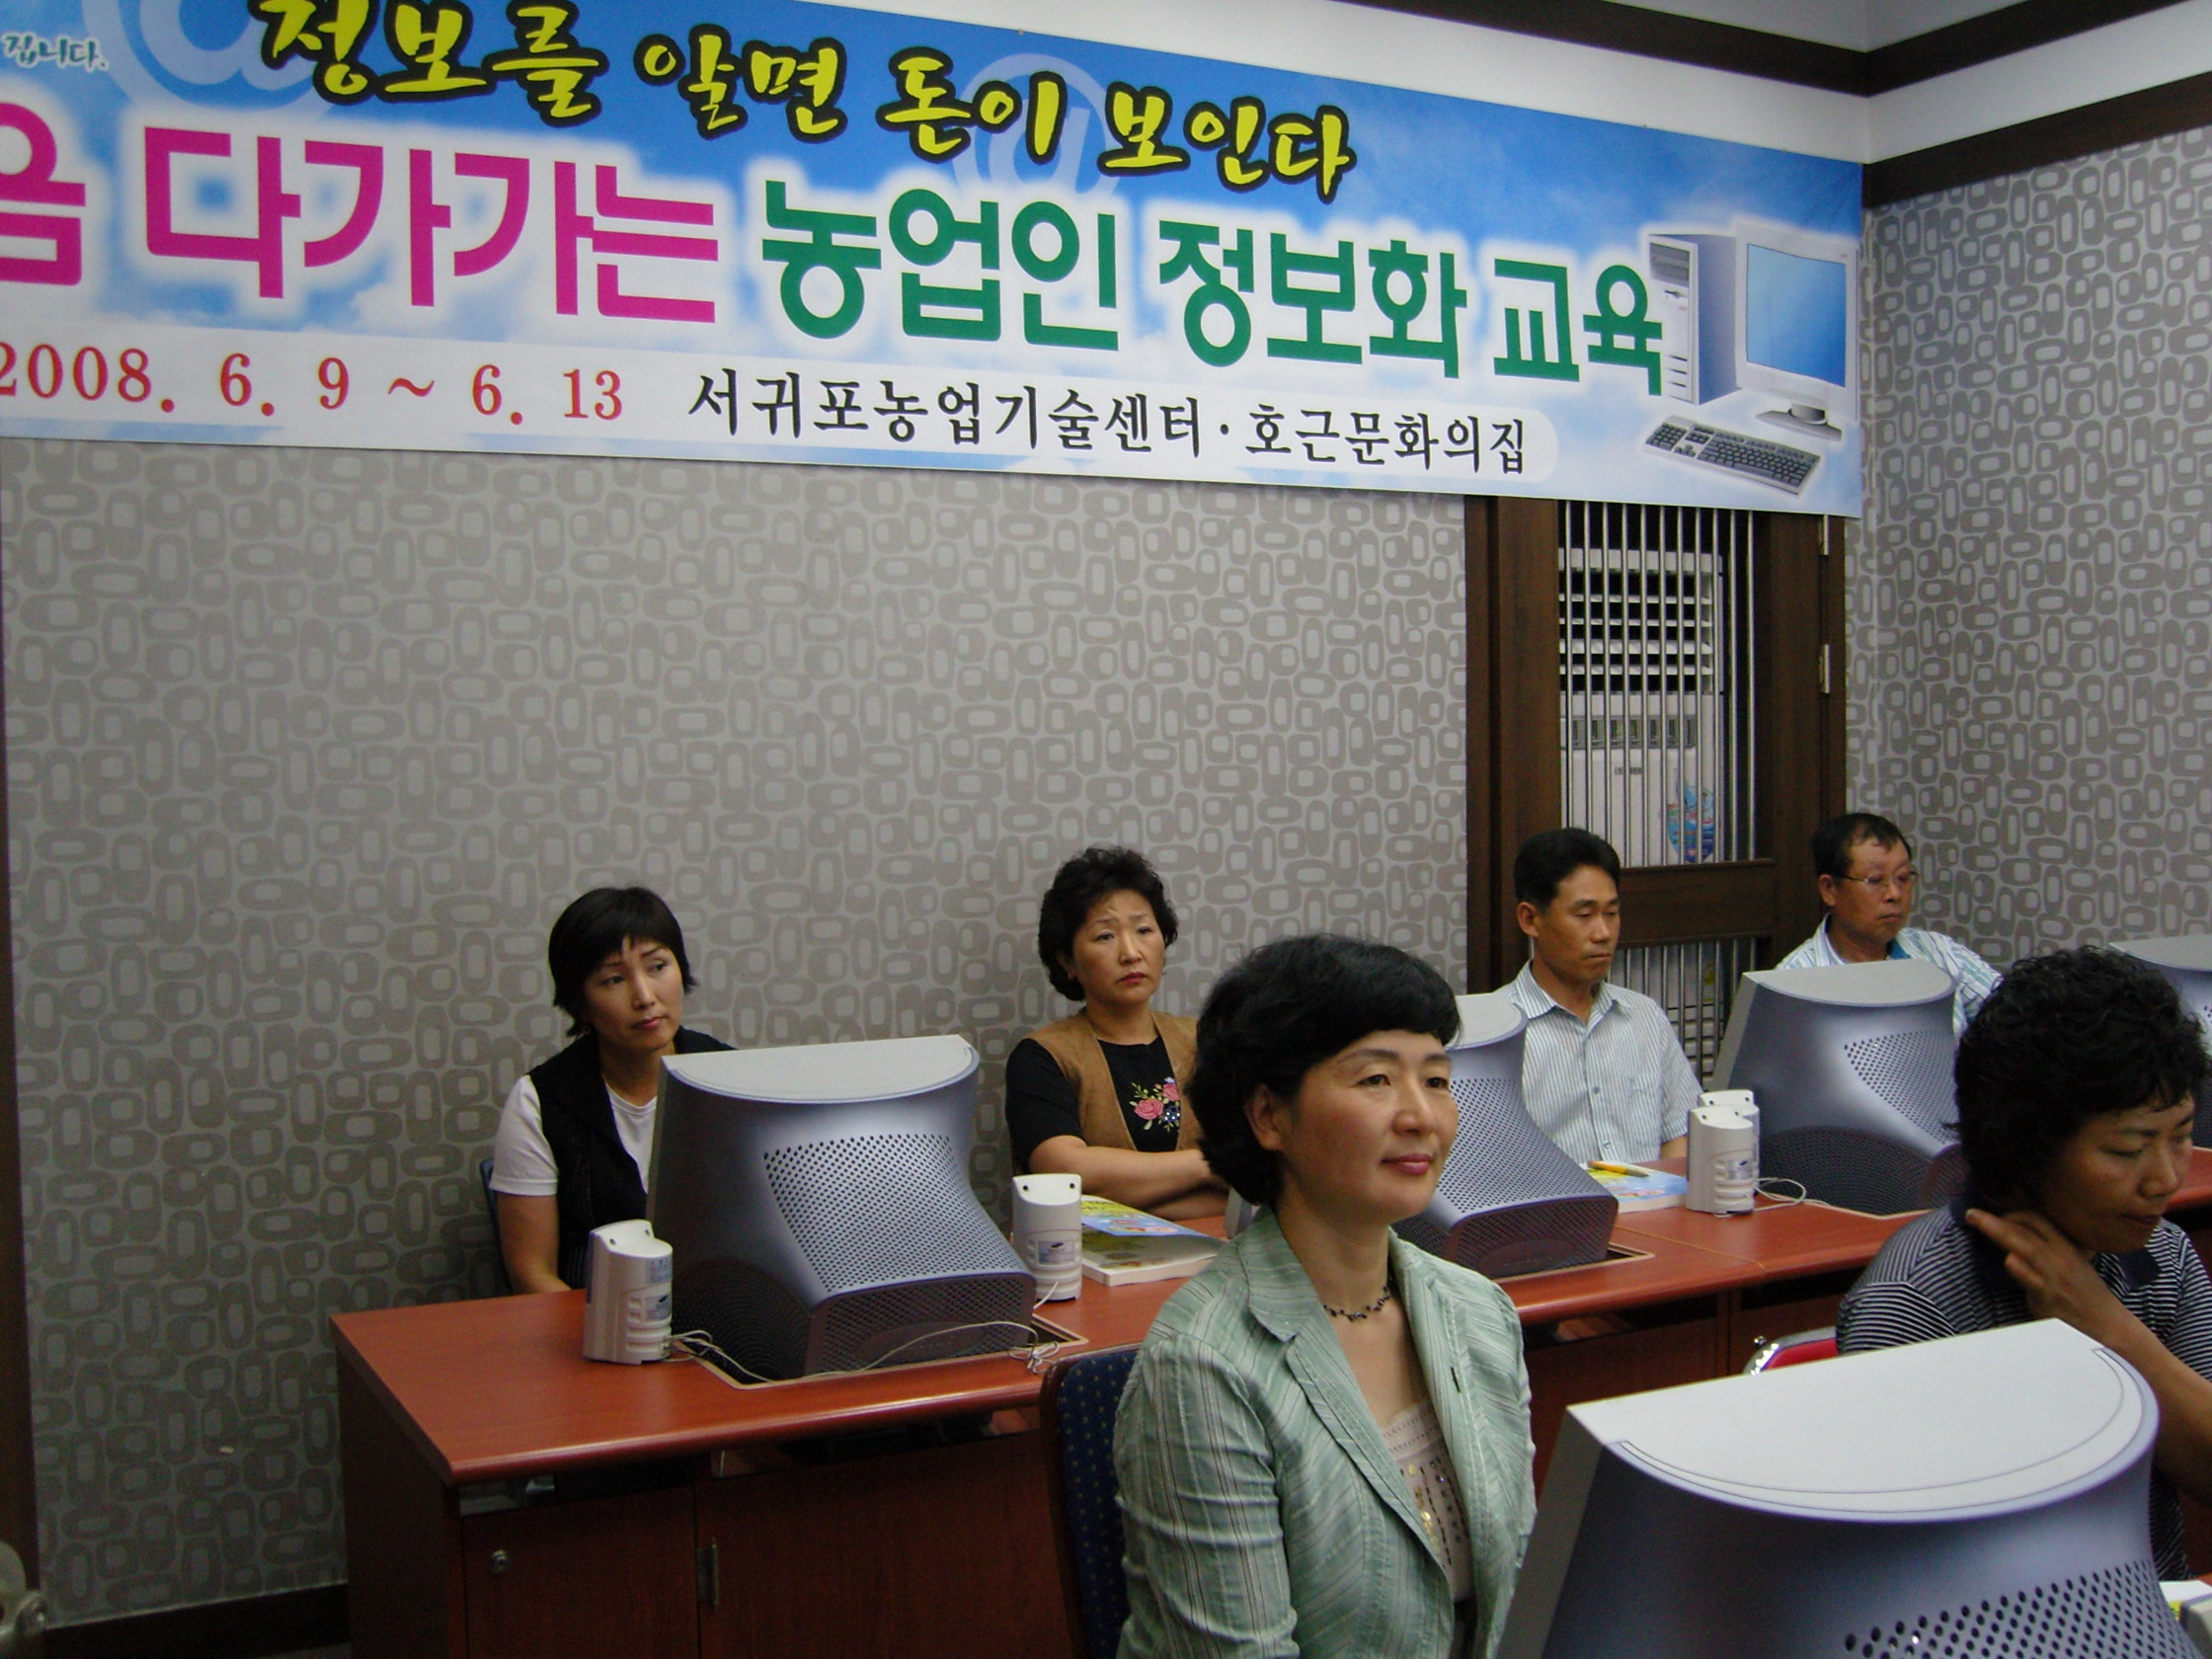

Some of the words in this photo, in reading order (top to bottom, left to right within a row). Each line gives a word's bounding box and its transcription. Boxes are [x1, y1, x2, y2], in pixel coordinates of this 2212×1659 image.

[255, 0, 603, 122] 정보를
[639, 30, 841, 137] 알면
[881, 51, 1063, 159] 돈이
[1102, 87, 1353, 198] 보인다
[144, 126, 719, 323] 다가가는
[762, 180, 1119, 352] 농업인
[1158, 219, 1467, 379] 정보화
[1494, 259, 1663, 396] 교육
[317, 356, 350, 410] 9
[562, 368, 623, 421] 13
[1245, 403, 1525, 475] 호근문화의집
